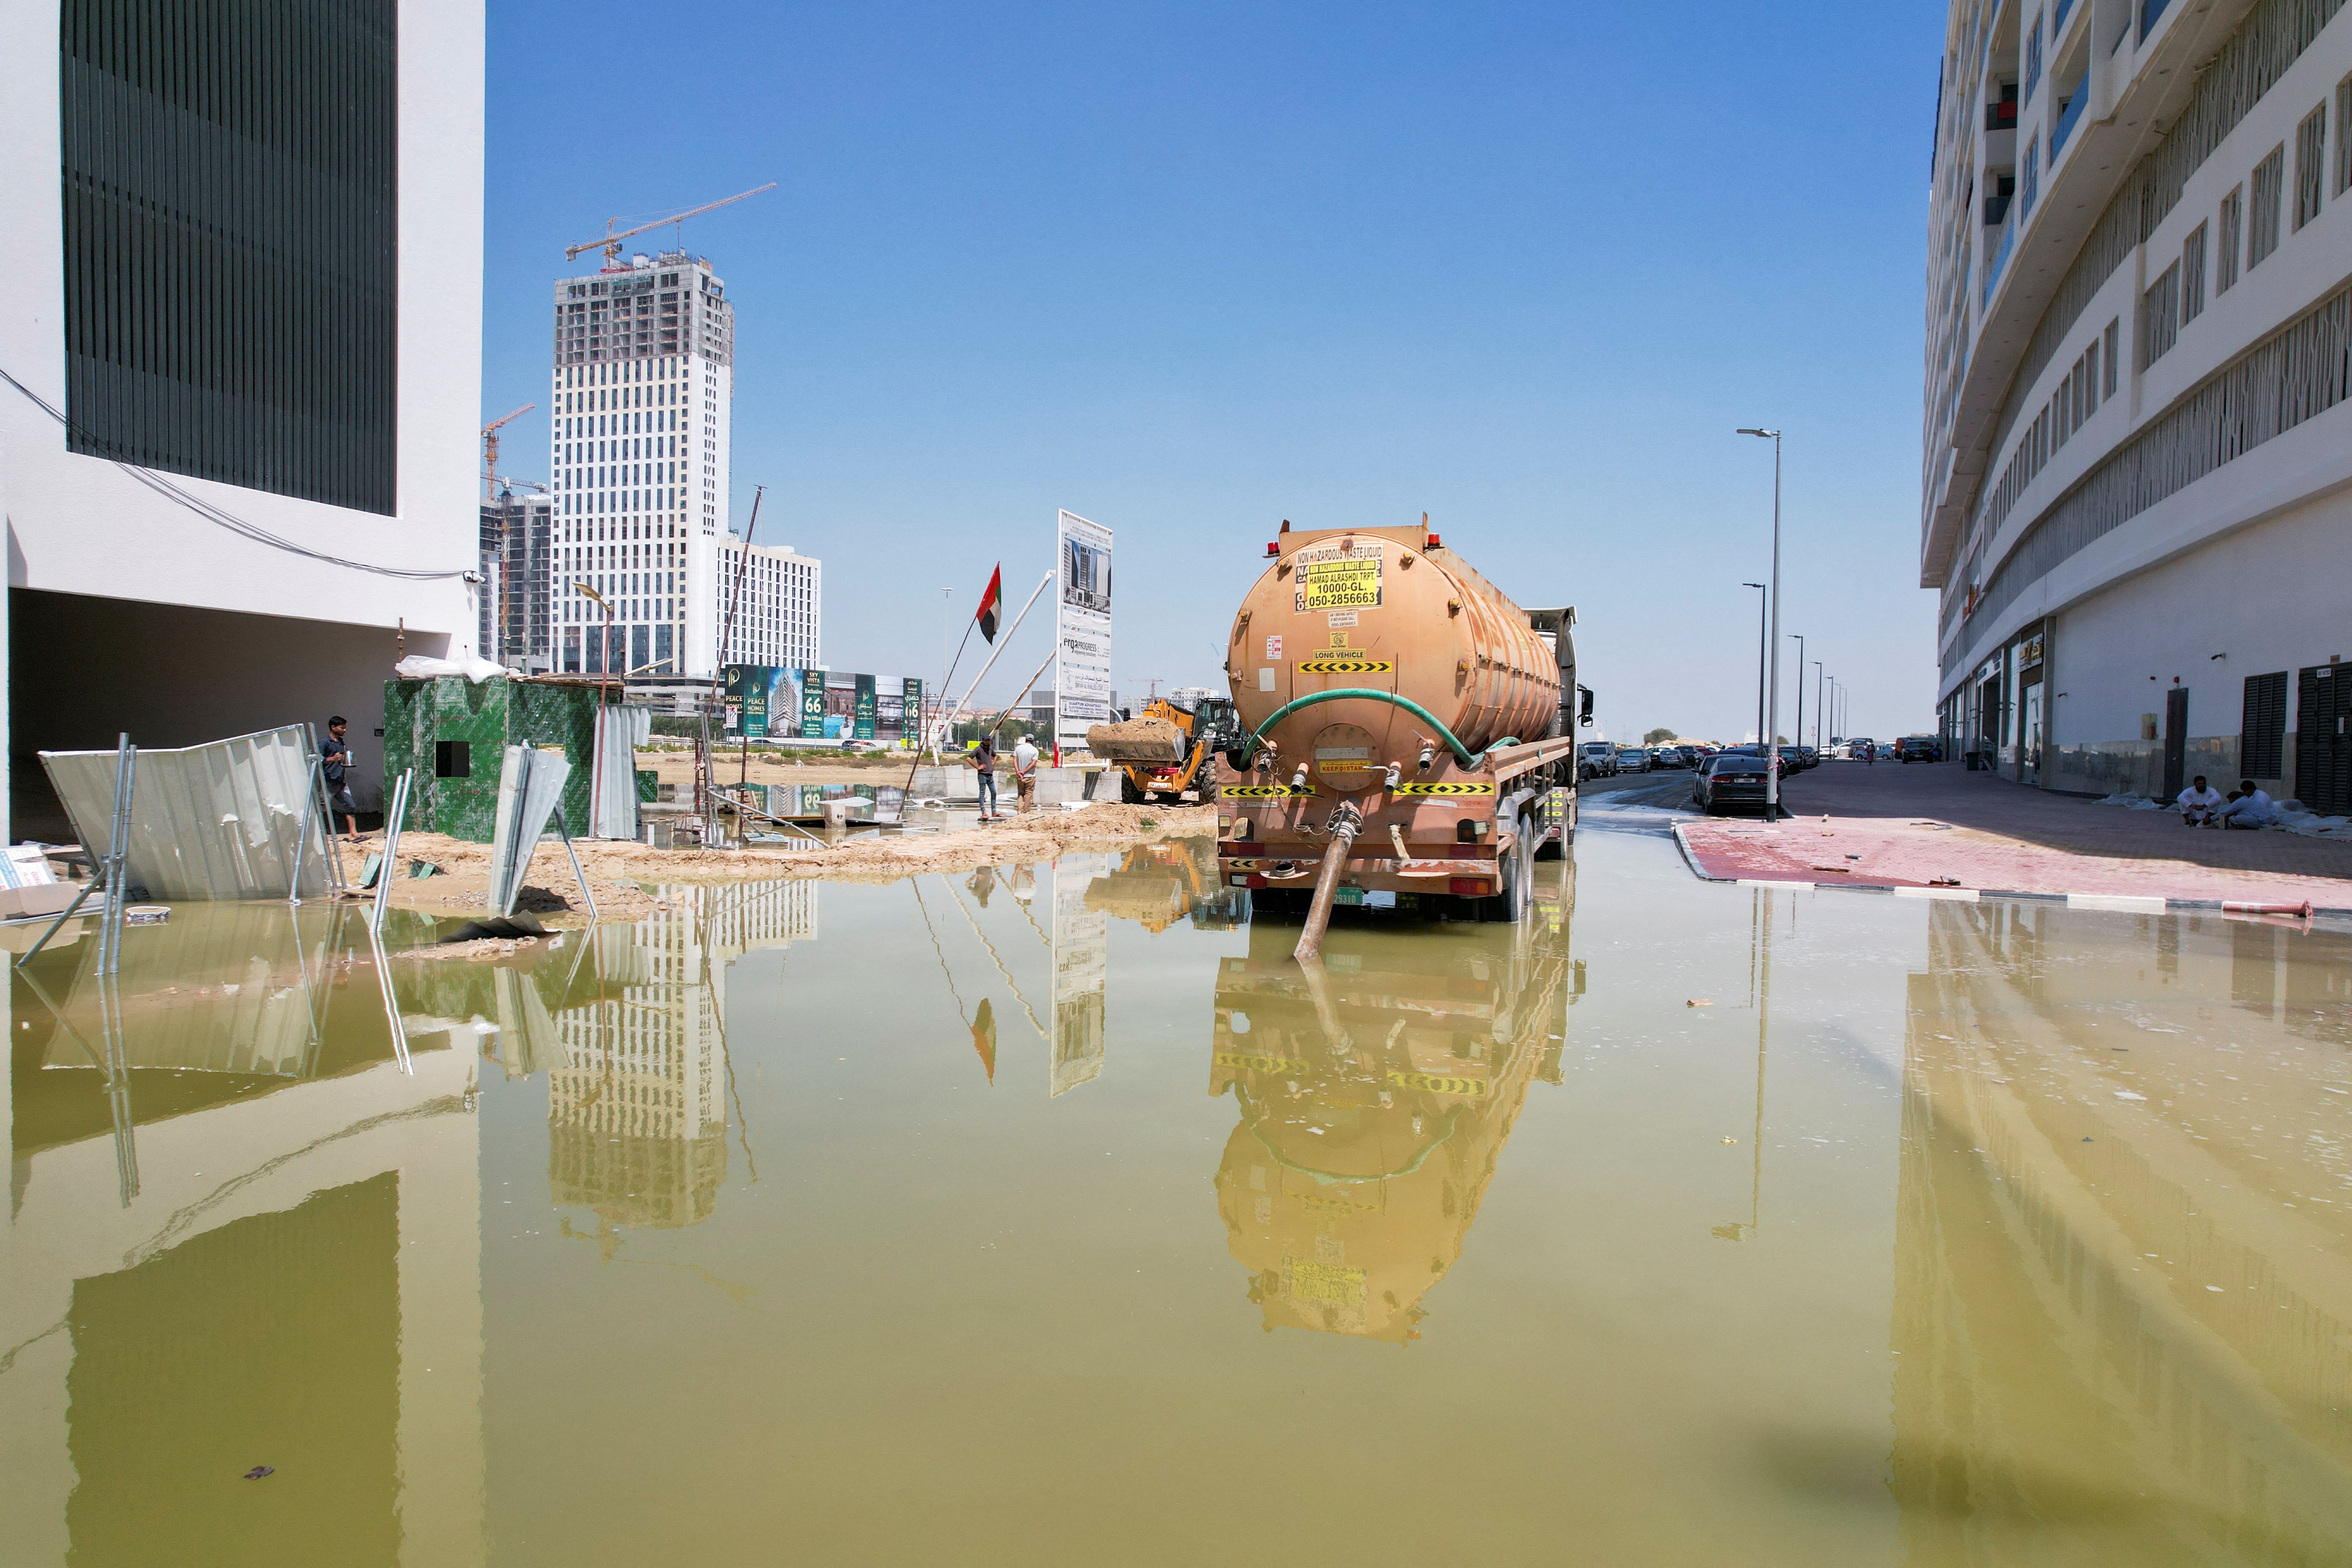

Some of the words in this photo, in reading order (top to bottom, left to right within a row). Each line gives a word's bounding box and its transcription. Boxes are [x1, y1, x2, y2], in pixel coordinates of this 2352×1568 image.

[1298, 551, 1309, 564] NON
[1364, 546, 1382, 558] LIQUID
[1310, 566, 1318, 574] NON
[1319, 563, 1344, 572] HAZARDOUS
[1345, 562, 1360, 570] WASTE
[1360, 561, 1375, 570] LIQUID
[1310, 574, 1329, 585] HAMAD
[1330, 573, 1358, 583] ALRASHDI
[1360, 572, 1375, 581] TRPT.
[1317, 582, 1367, 594] 10000-GL.
[1309, 592, 1375, 606] 050-2856663
[805, 697, 821, 713] 66
[1334, 894, 1356, 903] 29310
